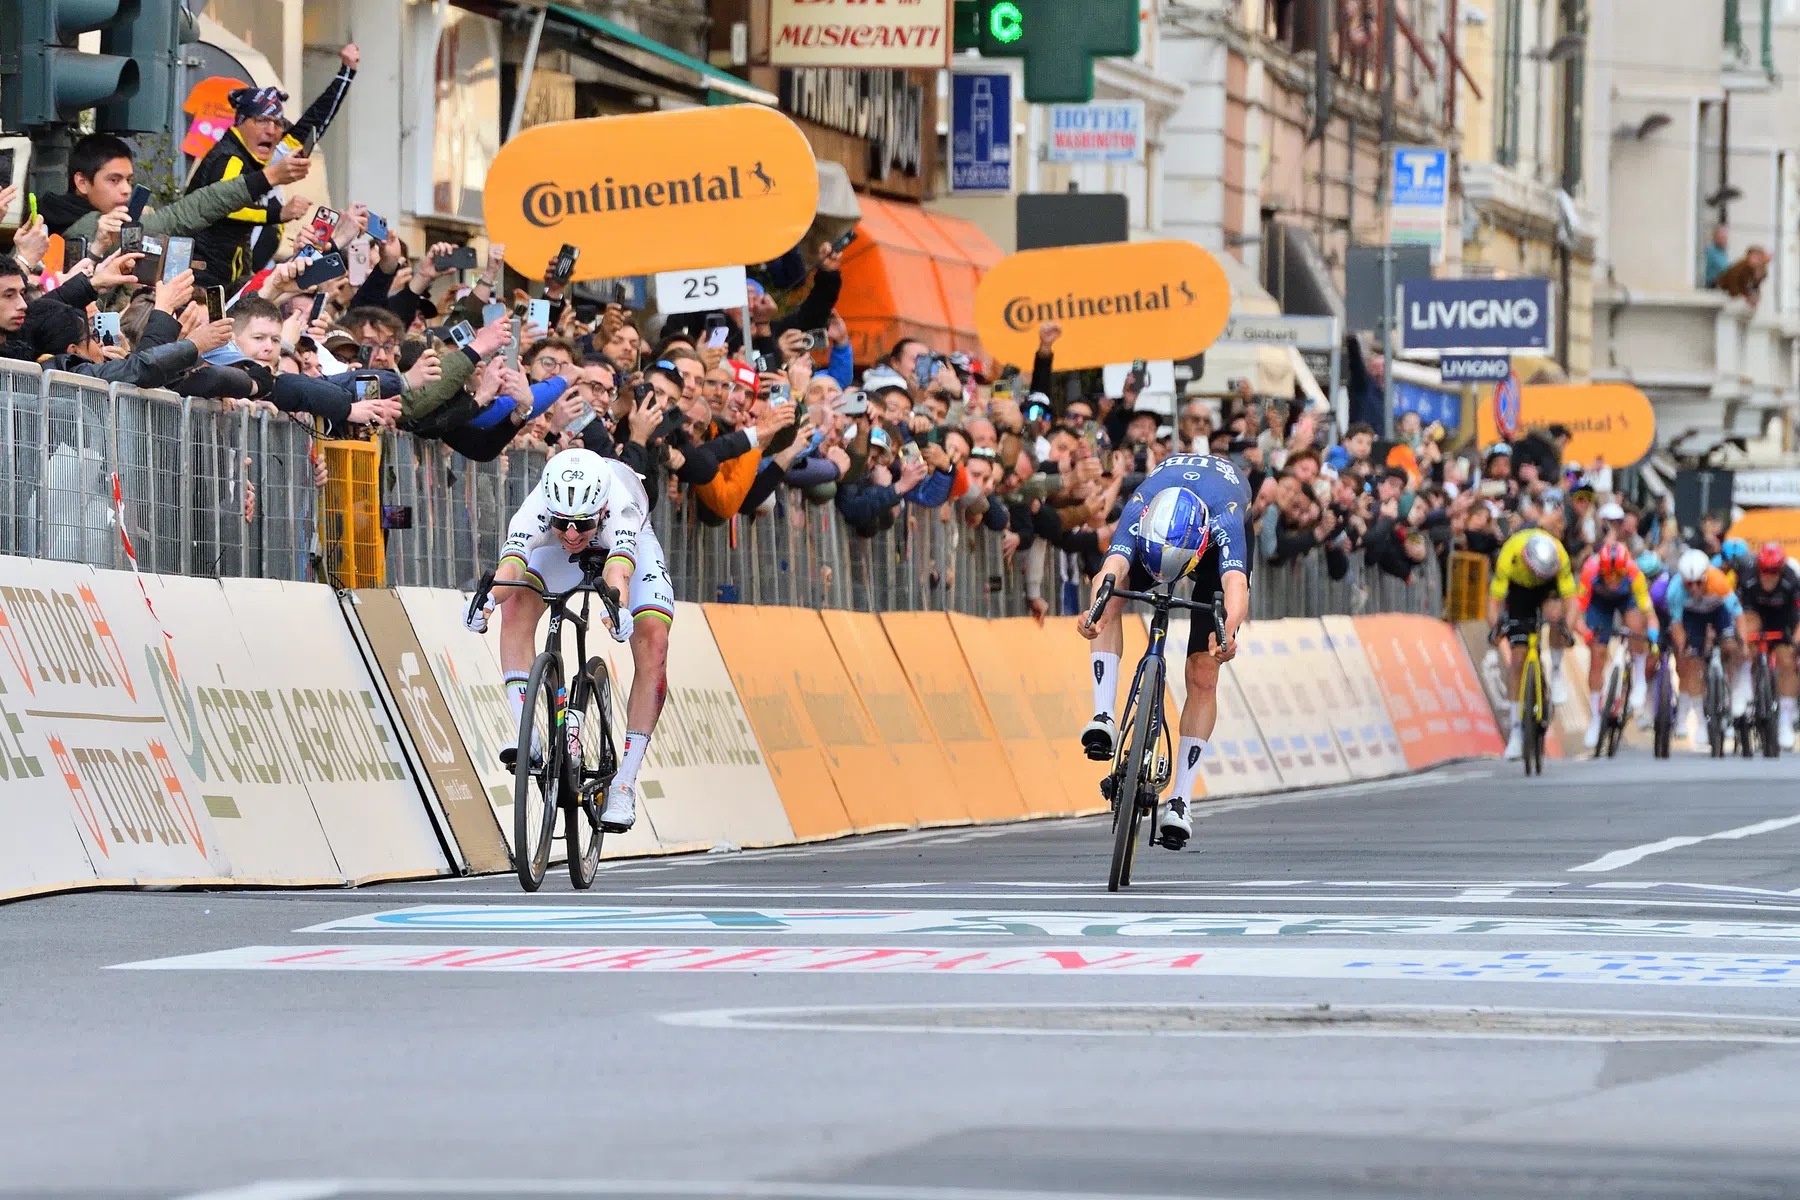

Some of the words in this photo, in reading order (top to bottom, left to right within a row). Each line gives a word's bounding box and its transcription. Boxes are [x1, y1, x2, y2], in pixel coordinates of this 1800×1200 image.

[776, 24, 941, 49] MUSICANTI
[1054, 107, 1137, 129] HOTEL
[522, 165, 744, 228] Continental
[683, 275, 720, 299] 25
[1003, 283, 1170, 333] Continental
[1410, 297, 1539, 330] LIVIGNO
[1441, 359, 1509, 378] LIVIGNO
[561, 469, 585, 483] G42
[1111, 544, 1132, 555] SGS
[1222, 559, 1244, 569] SGS
[277, 687, 407, 784] AGRICOLE
